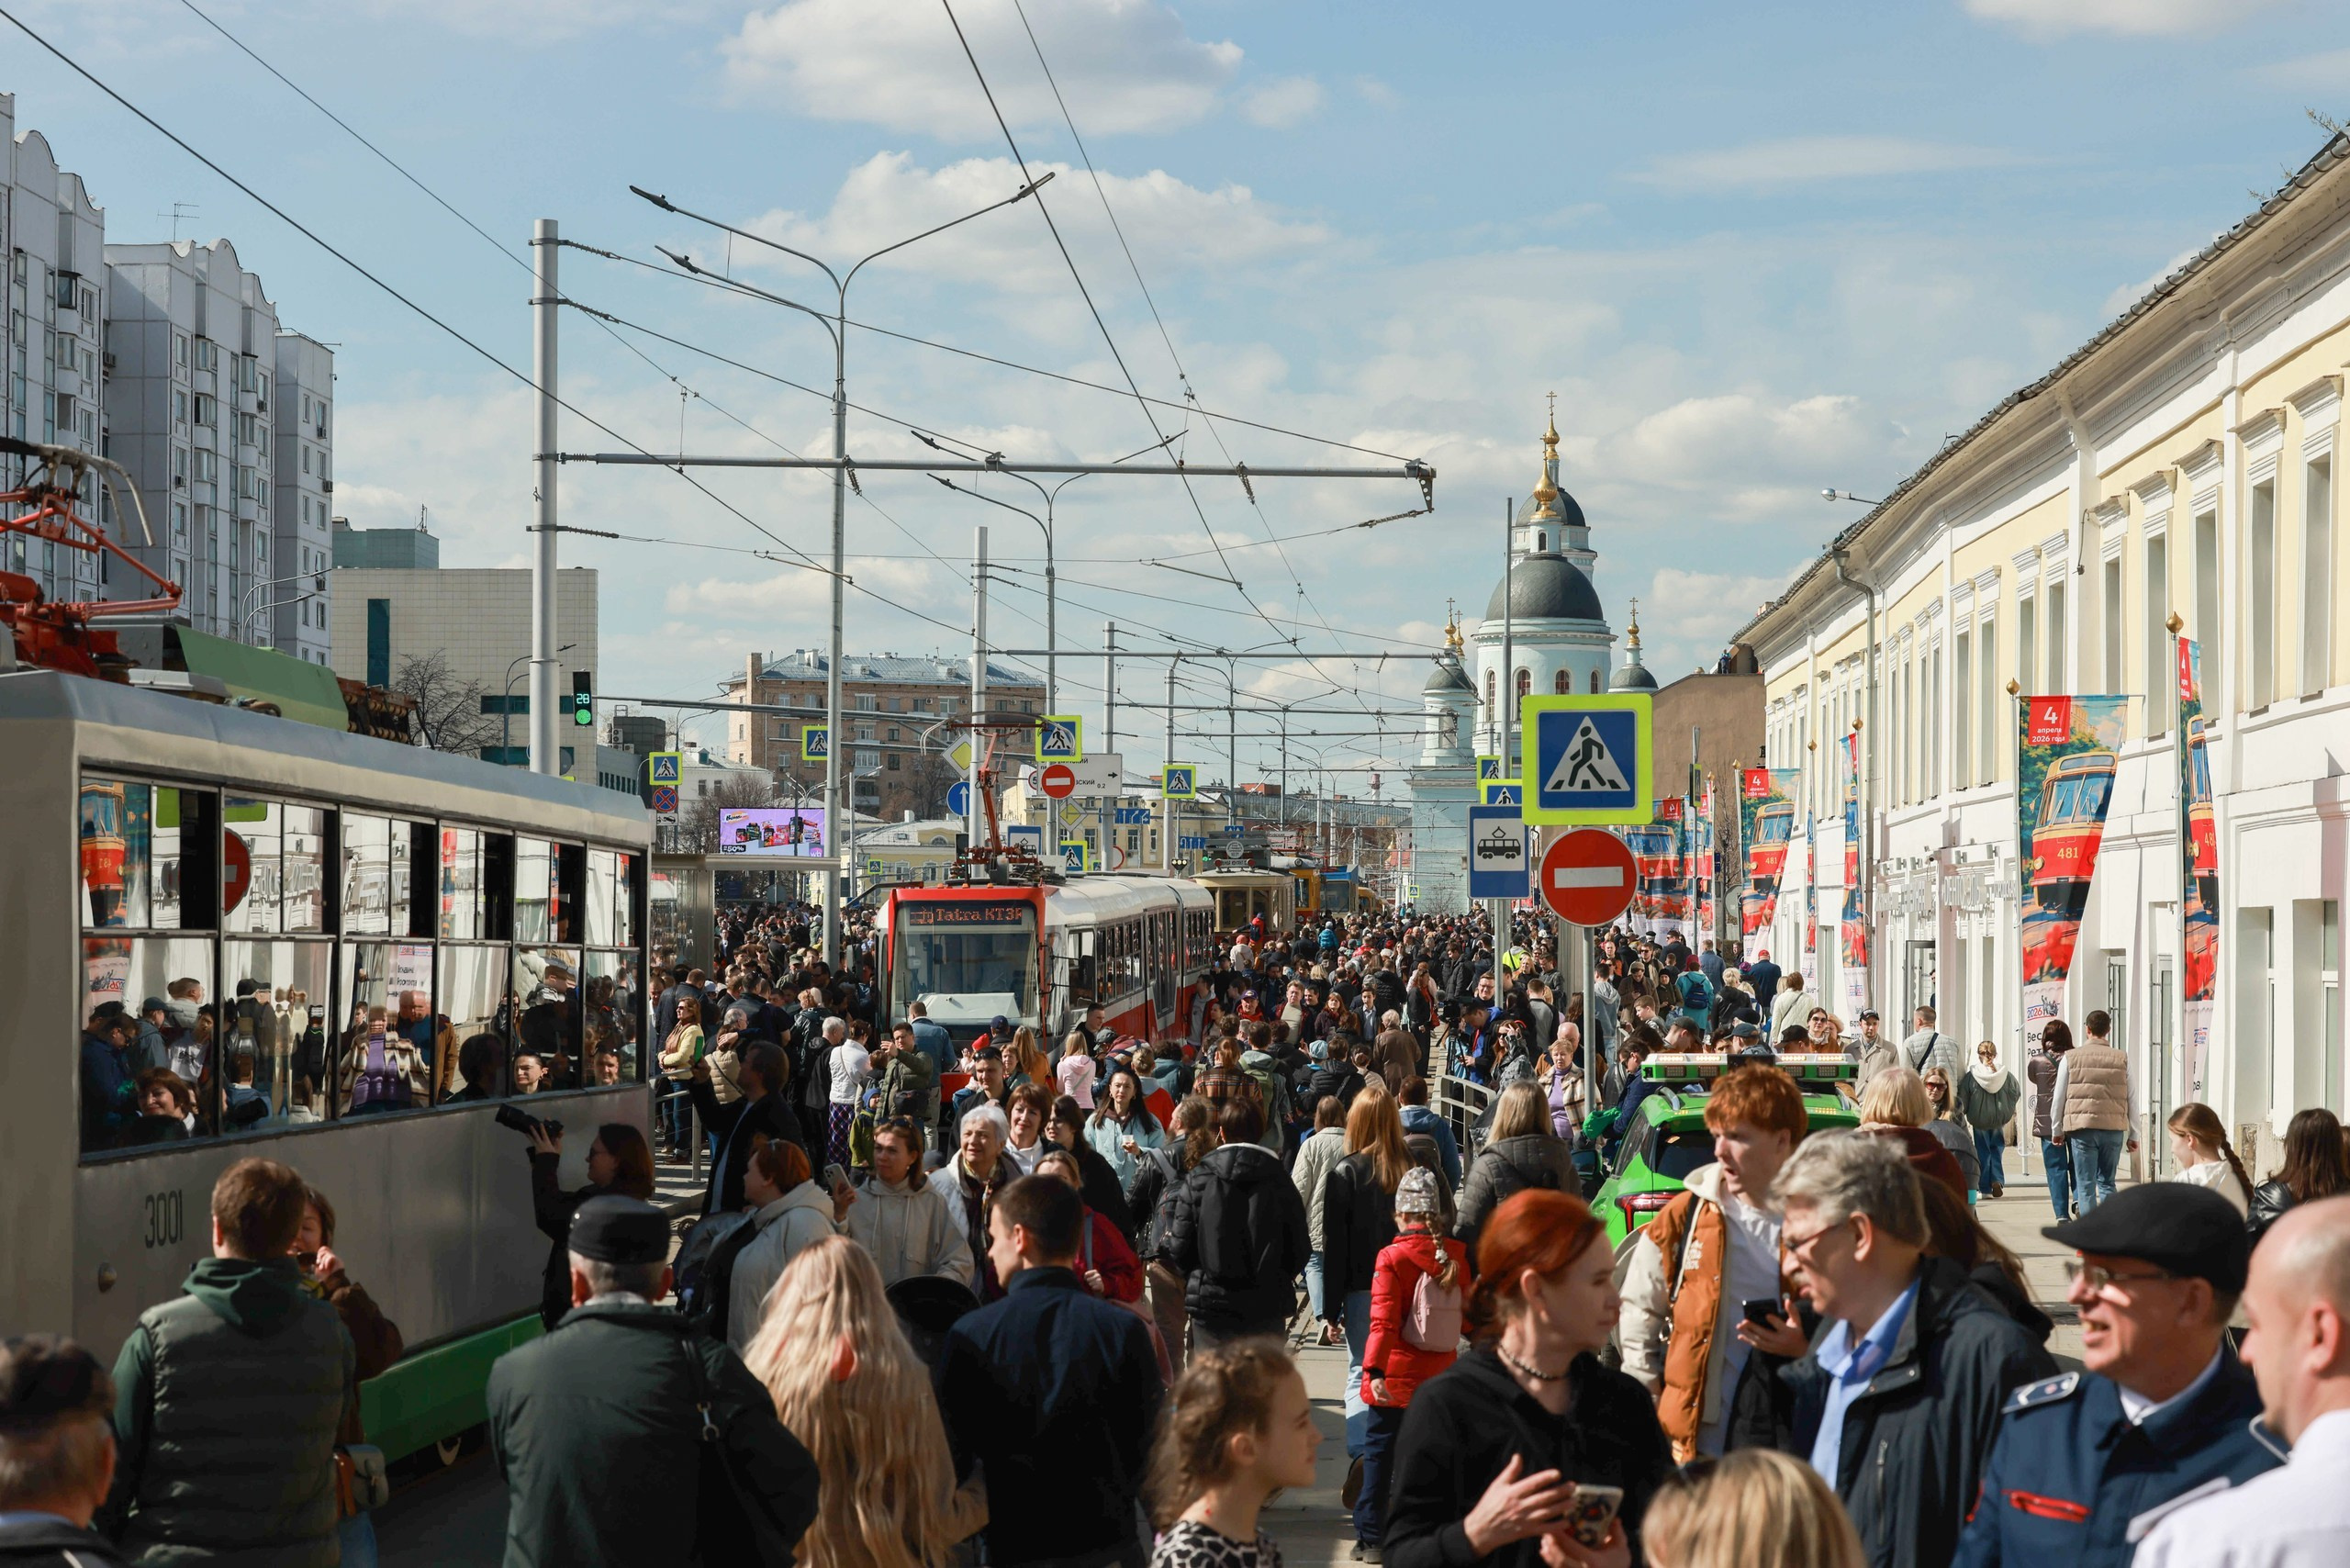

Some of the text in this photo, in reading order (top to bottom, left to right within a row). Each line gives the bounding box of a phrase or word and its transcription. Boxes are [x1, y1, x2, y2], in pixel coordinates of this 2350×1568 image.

[576, 693, 590, 704] 28
[2043, 706, 2058, 724] 4
[1751, 775, 1762, 786] 4
[2056, 846, 2079, 859] 481
[1765, 857, 1777, 865] 481
[935, 908, 982, 921] Tatra
[2027, 1007, 2043, 1019] 2026
[144, 1189, 183, 1249] 3001
